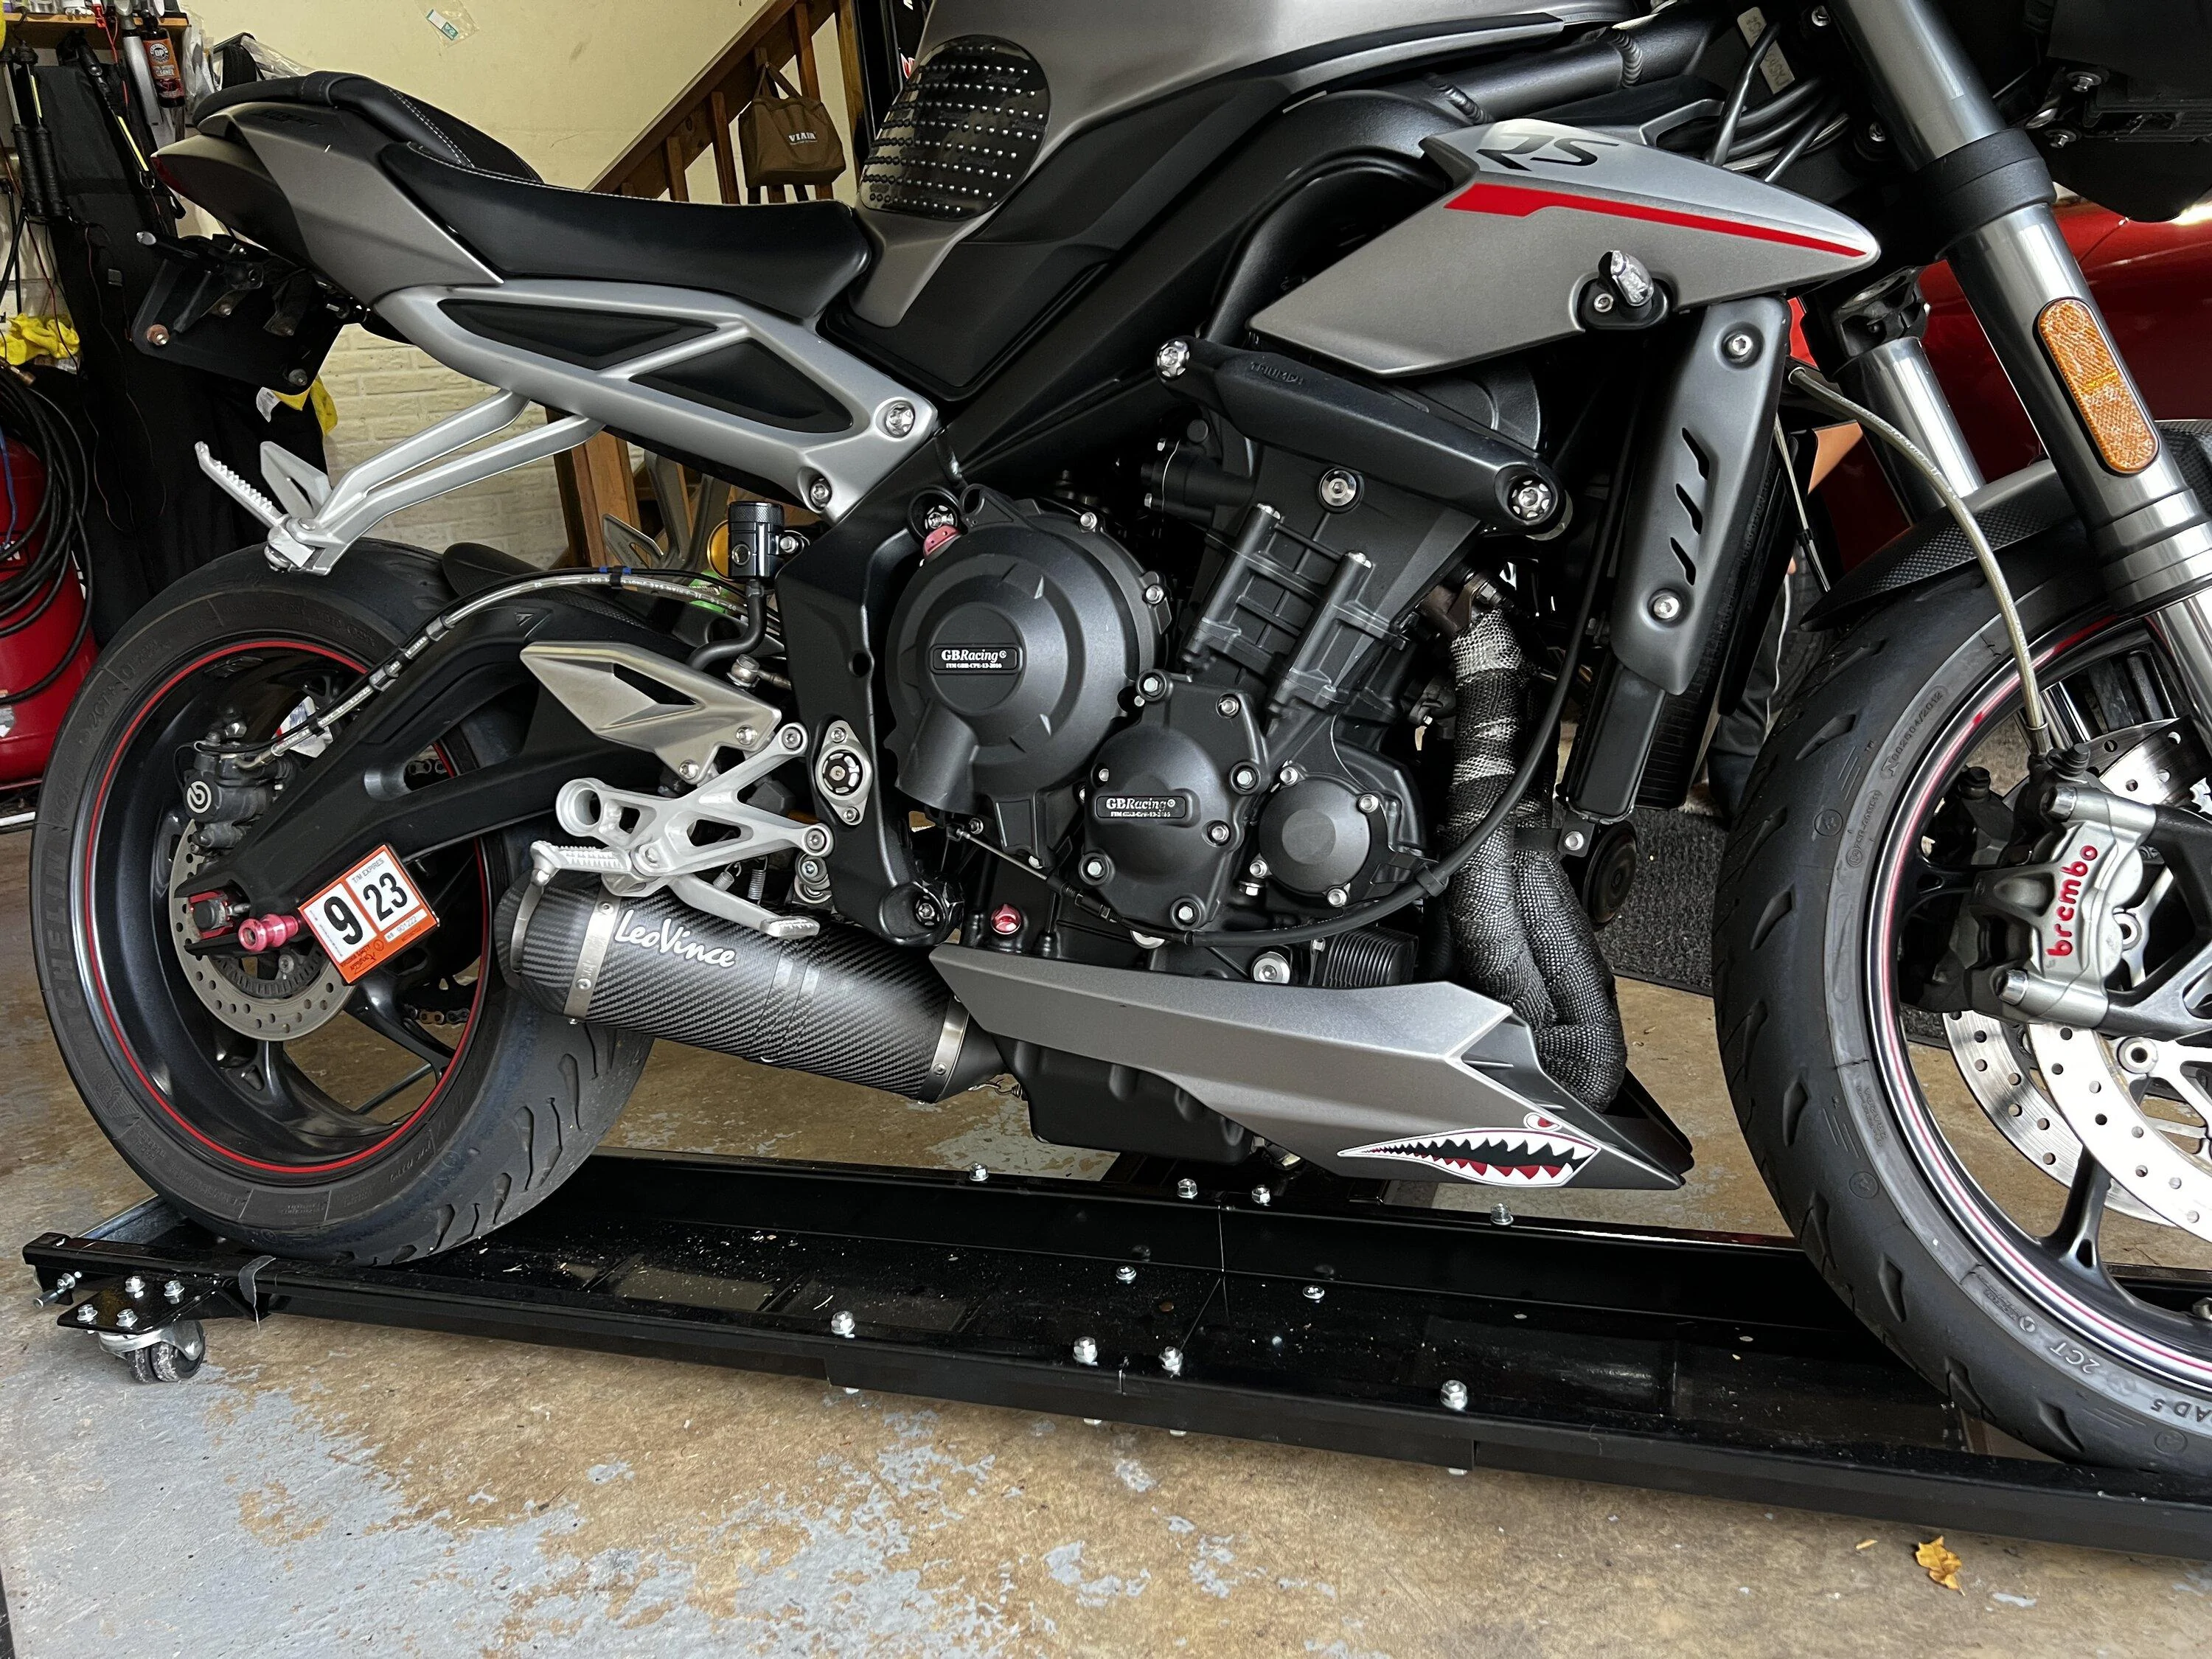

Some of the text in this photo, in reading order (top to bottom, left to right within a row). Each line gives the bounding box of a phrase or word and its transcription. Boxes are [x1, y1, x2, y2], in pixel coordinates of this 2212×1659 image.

[789, 132, 815, 142] VIAIR
[1475, 132, 1619, 172] RS
[362, 858, 385, 876] EXPIRES
[324, 896, 364, 945] 9
[363, 872, 408, 922] 23
[2046, 845, 2098, 956] brembo
[614, 909, 736, 967] LeoVince
[2050, 1342, 2100, 1374] 2CT
